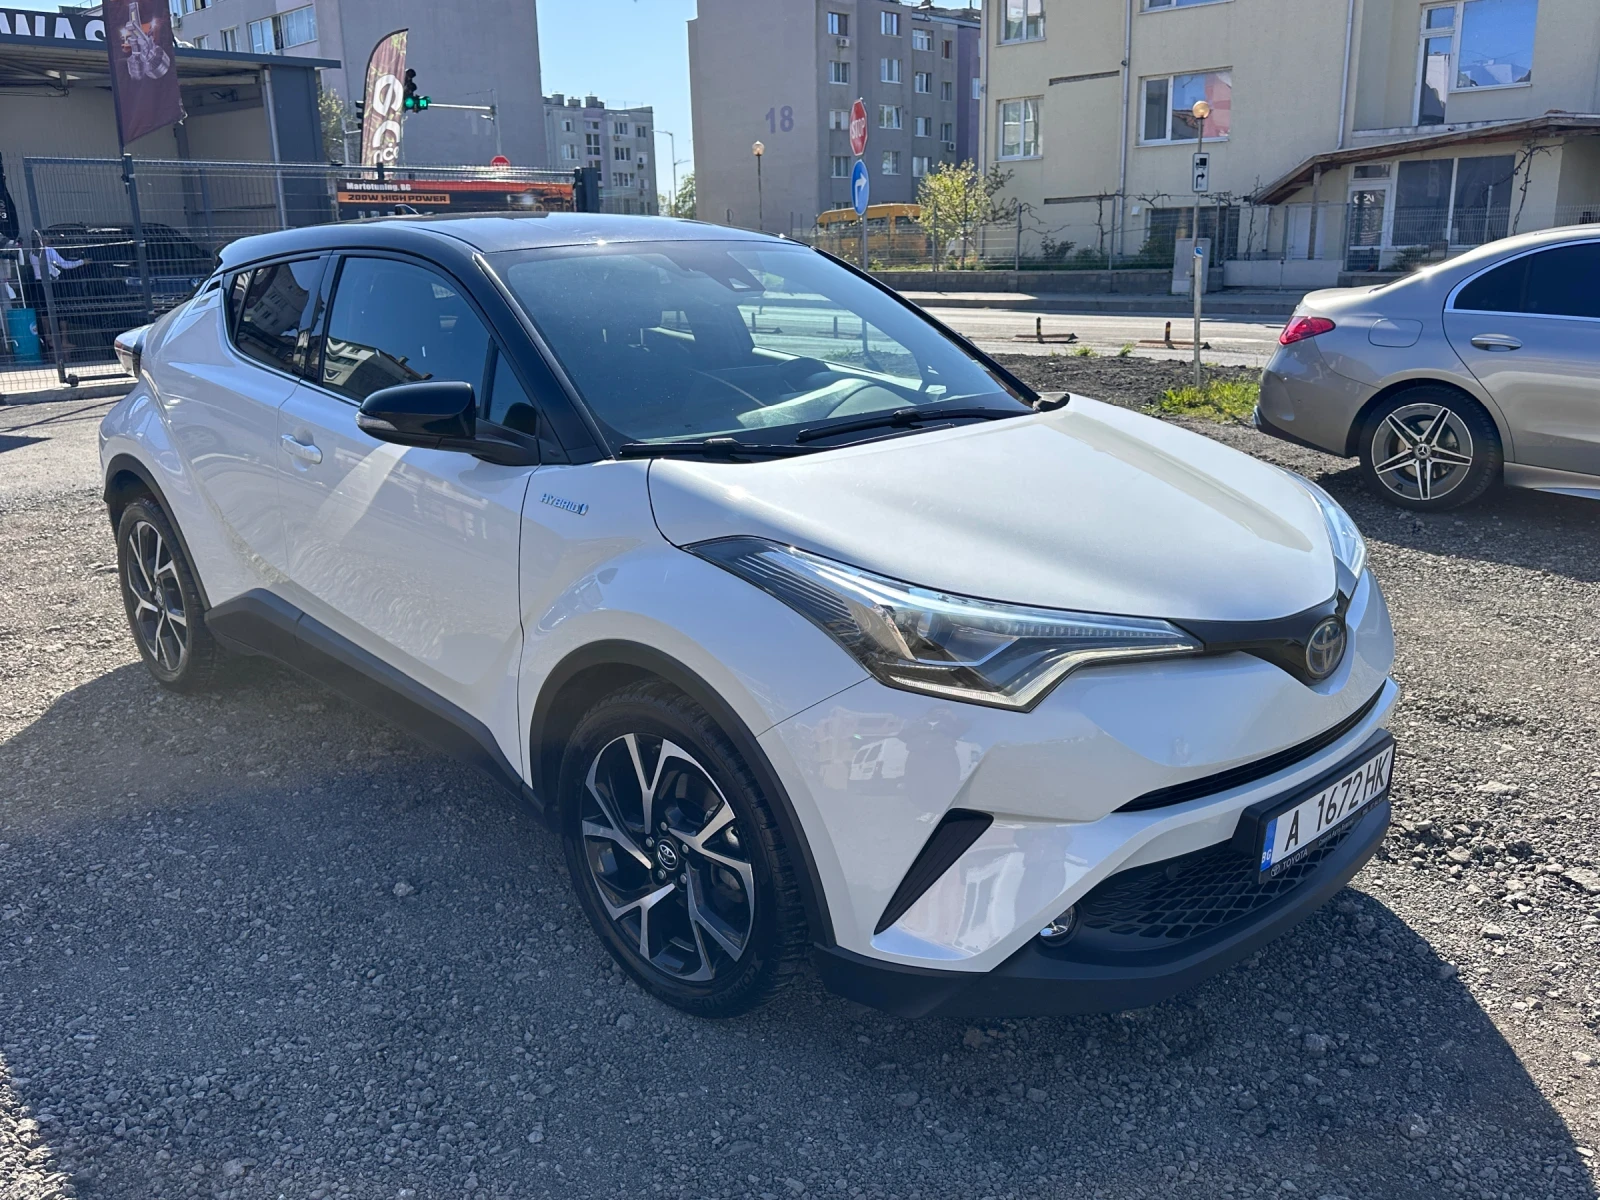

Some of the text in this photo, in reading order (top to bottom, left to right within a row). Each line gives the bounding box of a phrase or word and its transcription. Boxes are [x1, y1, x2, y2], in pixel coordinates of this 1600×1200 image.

[766, 105, 794, 134] 18
[851, 117, 866, 139] STOP
[540, 493, 580, 514] HYBRID
[1284, 809, 1299, 852] A
[1261, 850, 1272, 864] BG
[1282, 848, 1308, 869] TOYOTA
